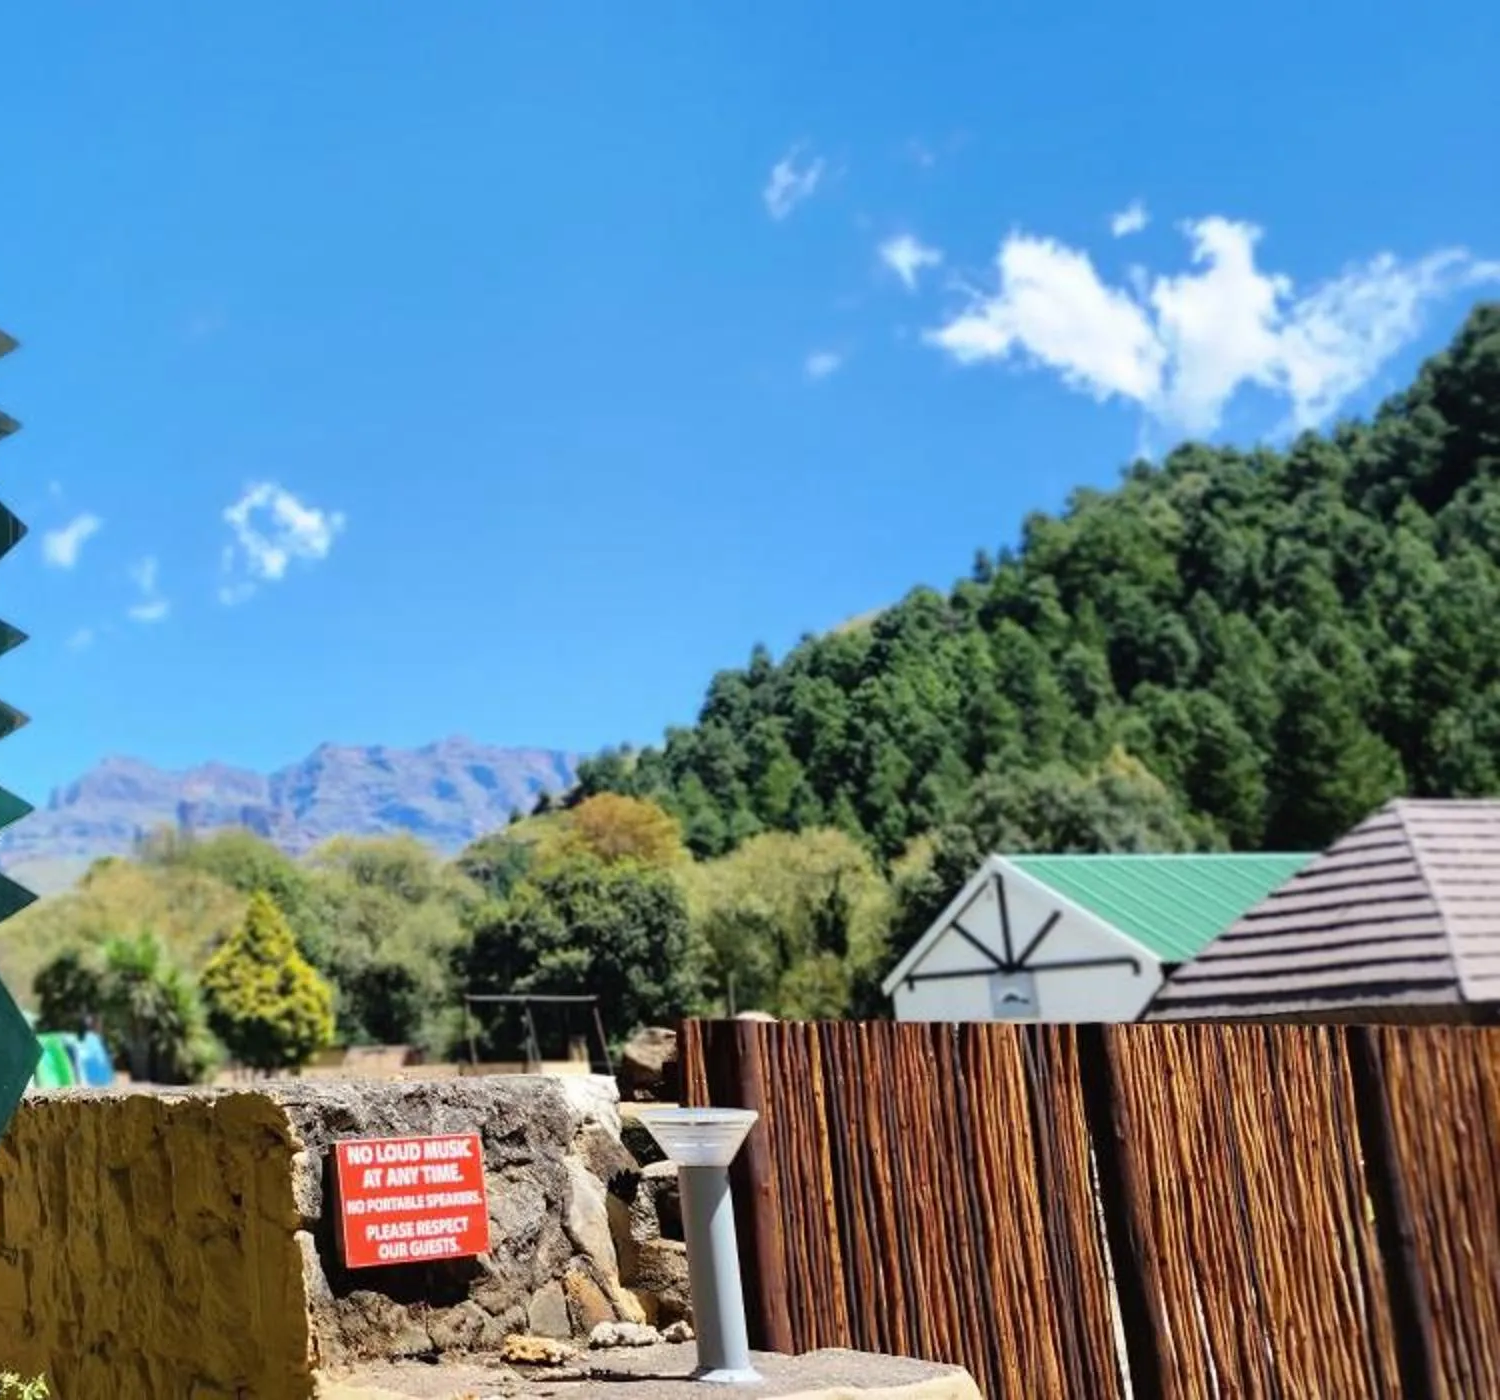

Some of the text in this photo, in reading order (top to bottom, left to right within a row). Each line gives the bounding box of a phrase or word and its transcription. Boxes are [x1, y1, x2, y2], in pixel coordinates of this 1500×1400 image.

[347, 1139, 473, 1165] NO LOUD MUSIC
[363, 1163, 464, 1189] AT ANY TIME.
[347, 1200, 365, 1215] NO
[367, 1196, 424, 1213] PORTABLE
[366, 1217, 468, 1242] PLEASE RESPECT
[378, 1238, 461, 1260] OUR GUESTS.
